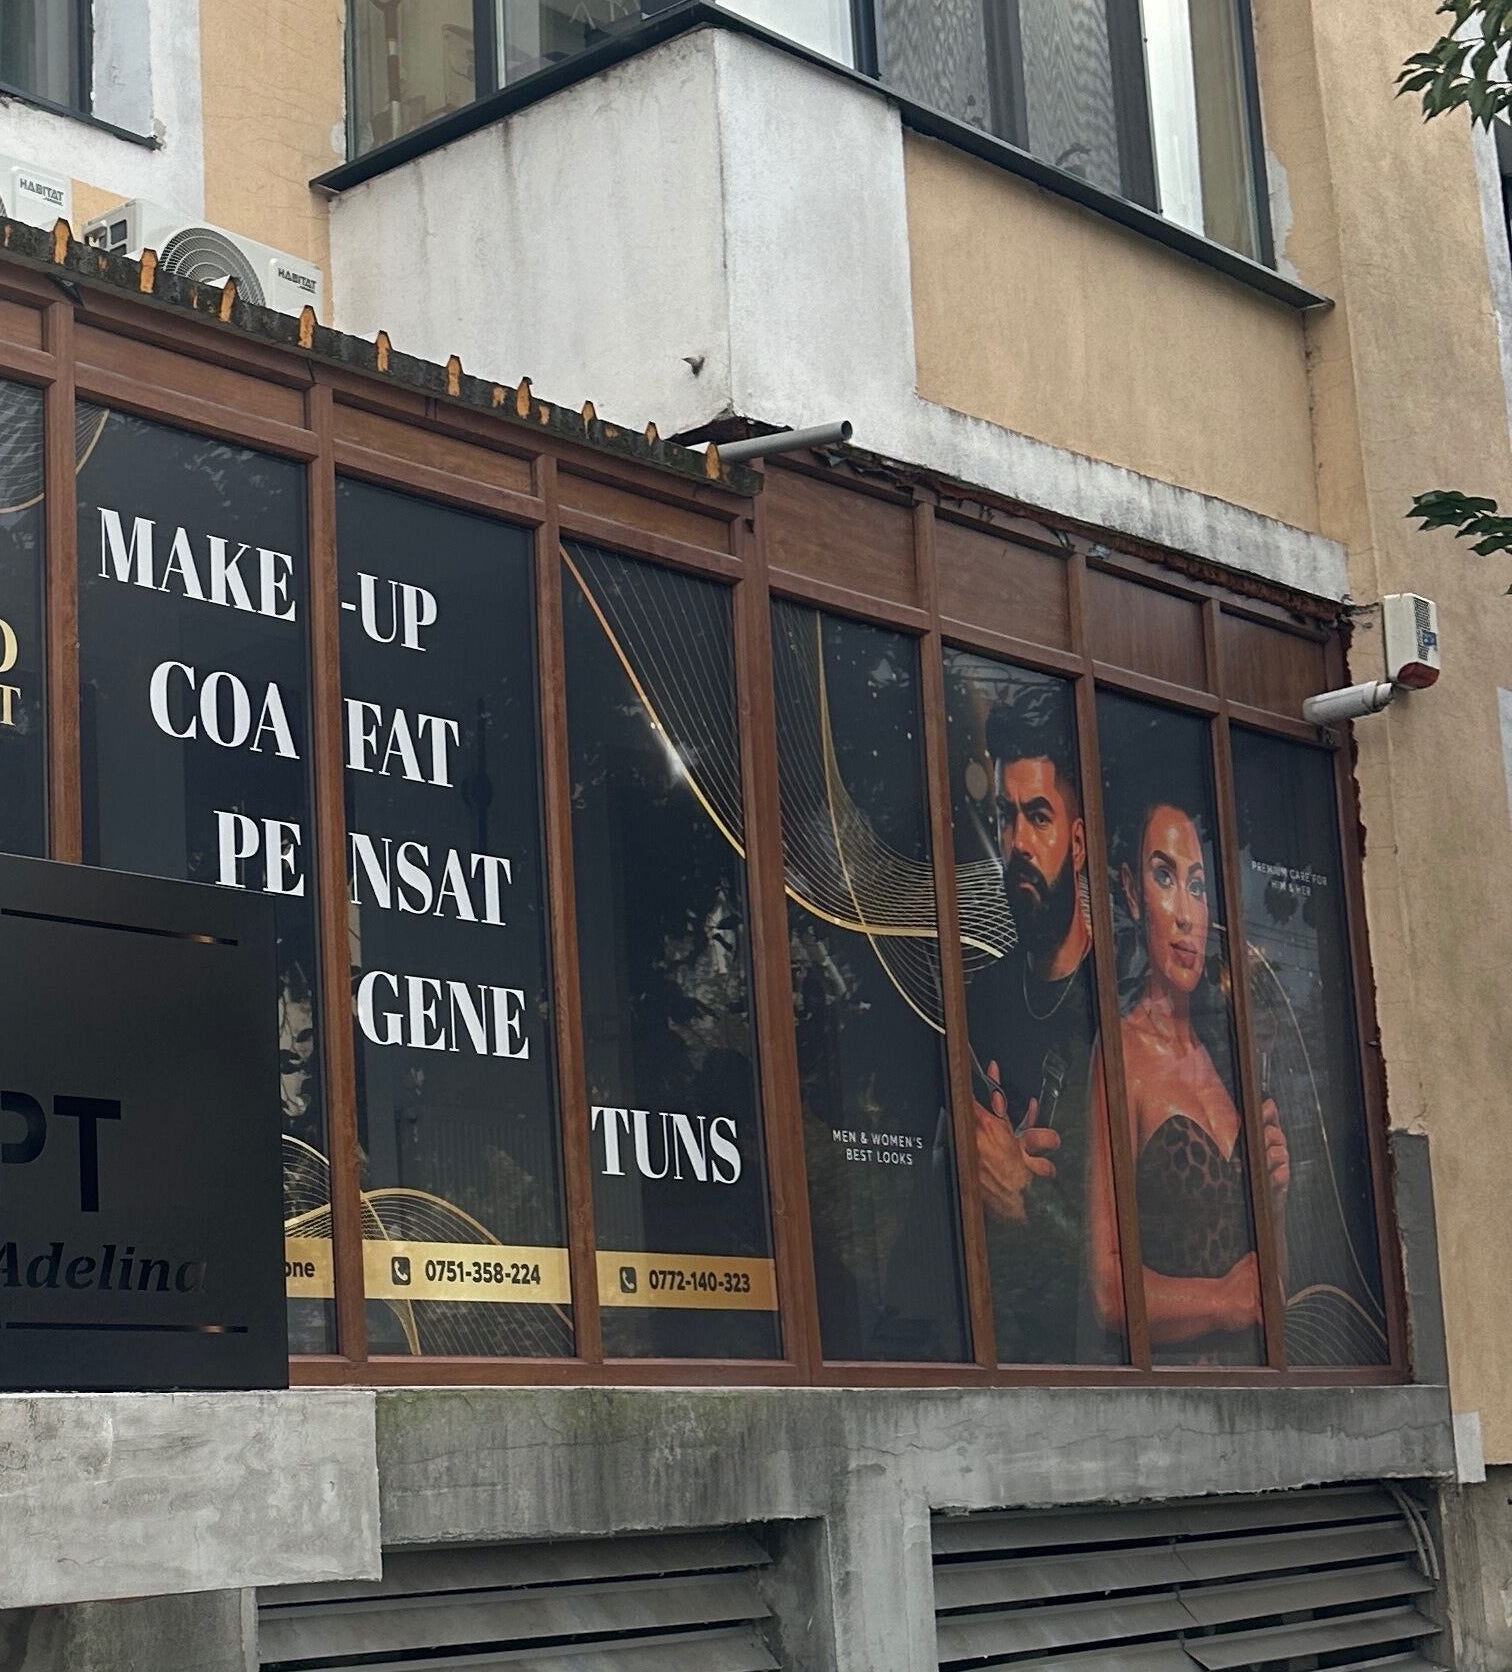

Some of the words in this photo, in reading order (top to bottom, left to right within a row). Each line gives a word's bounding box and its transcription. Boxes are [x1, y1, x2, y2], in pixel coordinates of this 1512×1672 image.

[19, 178, 64, 202] HABITAT
[96, 506, 297, 622] MAKE
[341, 571, 438, 652] -UP
[149, 660, 301, 760] COA
[343, 697, 460, 788] FAT
[213, 810, 305, 897] PE
[348, 831, 513, 926] NSAT
[1251, 860, 1288, 878] PREMM
[356, 970, 530, 1060] GENE
[590, 1105, 742, 1185] TUNS
[832, 1129, 857, 1143] MEN
[860, 1131, 868, 1144] &
[871, 1132, 923, 1149] WOMEN'S
[846, 1148, 873, 1162] BEST
[876, 1150, 913, 1166] LOOKS
[424, 1259, 541, 1286] 0751-358-224
[648, 1268, 751, 1293] 0772-140-323
